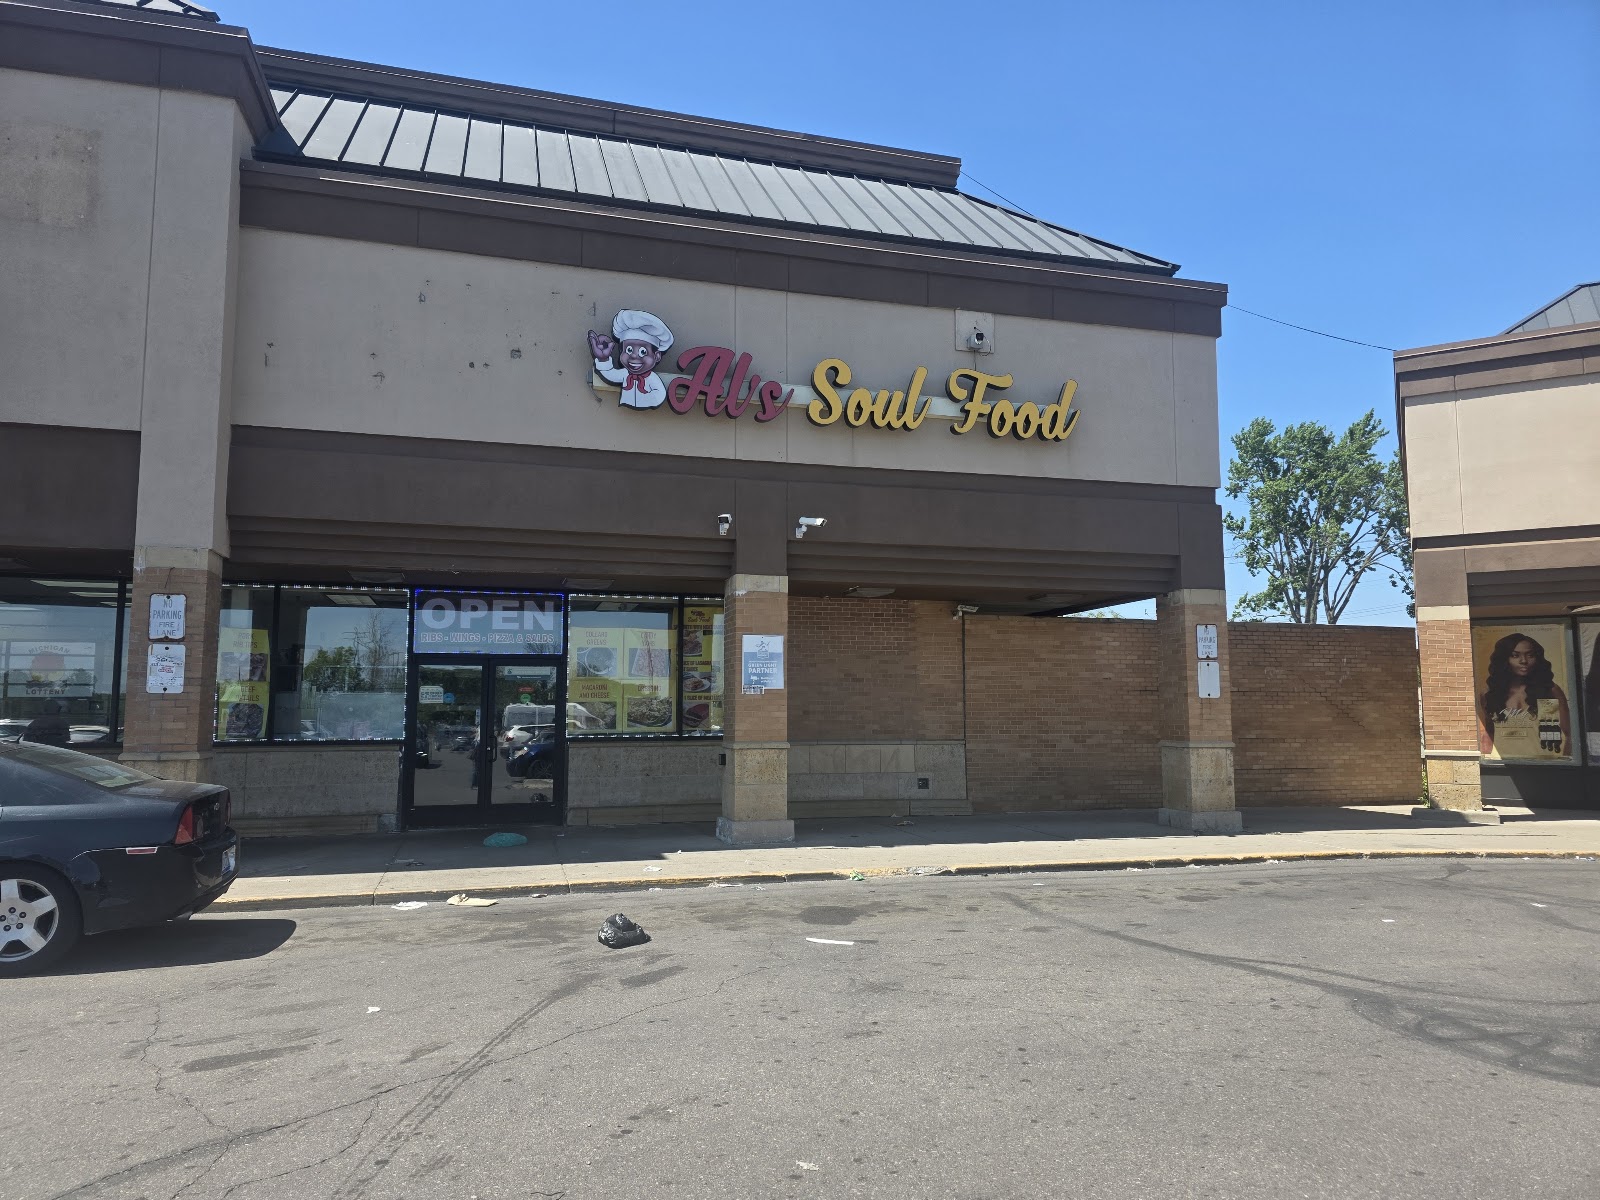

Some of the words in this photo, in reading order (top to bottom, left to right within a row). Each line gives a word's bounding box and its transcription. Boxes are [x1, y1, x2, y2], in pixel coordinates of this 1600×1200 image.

[667, 345, 795, 423] Al's
[807, 358, 933, 429] Soul
[945, 367, 1081, 442] Food
[163, 599, 173, 608] NO
[152, 610, 182, 620] PARKING
[422, 597, 554, 631] OPEN
[420, 632, 443, 642] RIBS
[449, 632, 481, 643] WINGS
[487, 632, 514, 643] PIZZA
[516, 633, 523, 643] &
[28, 645, 71, 654] MICHIGAN
